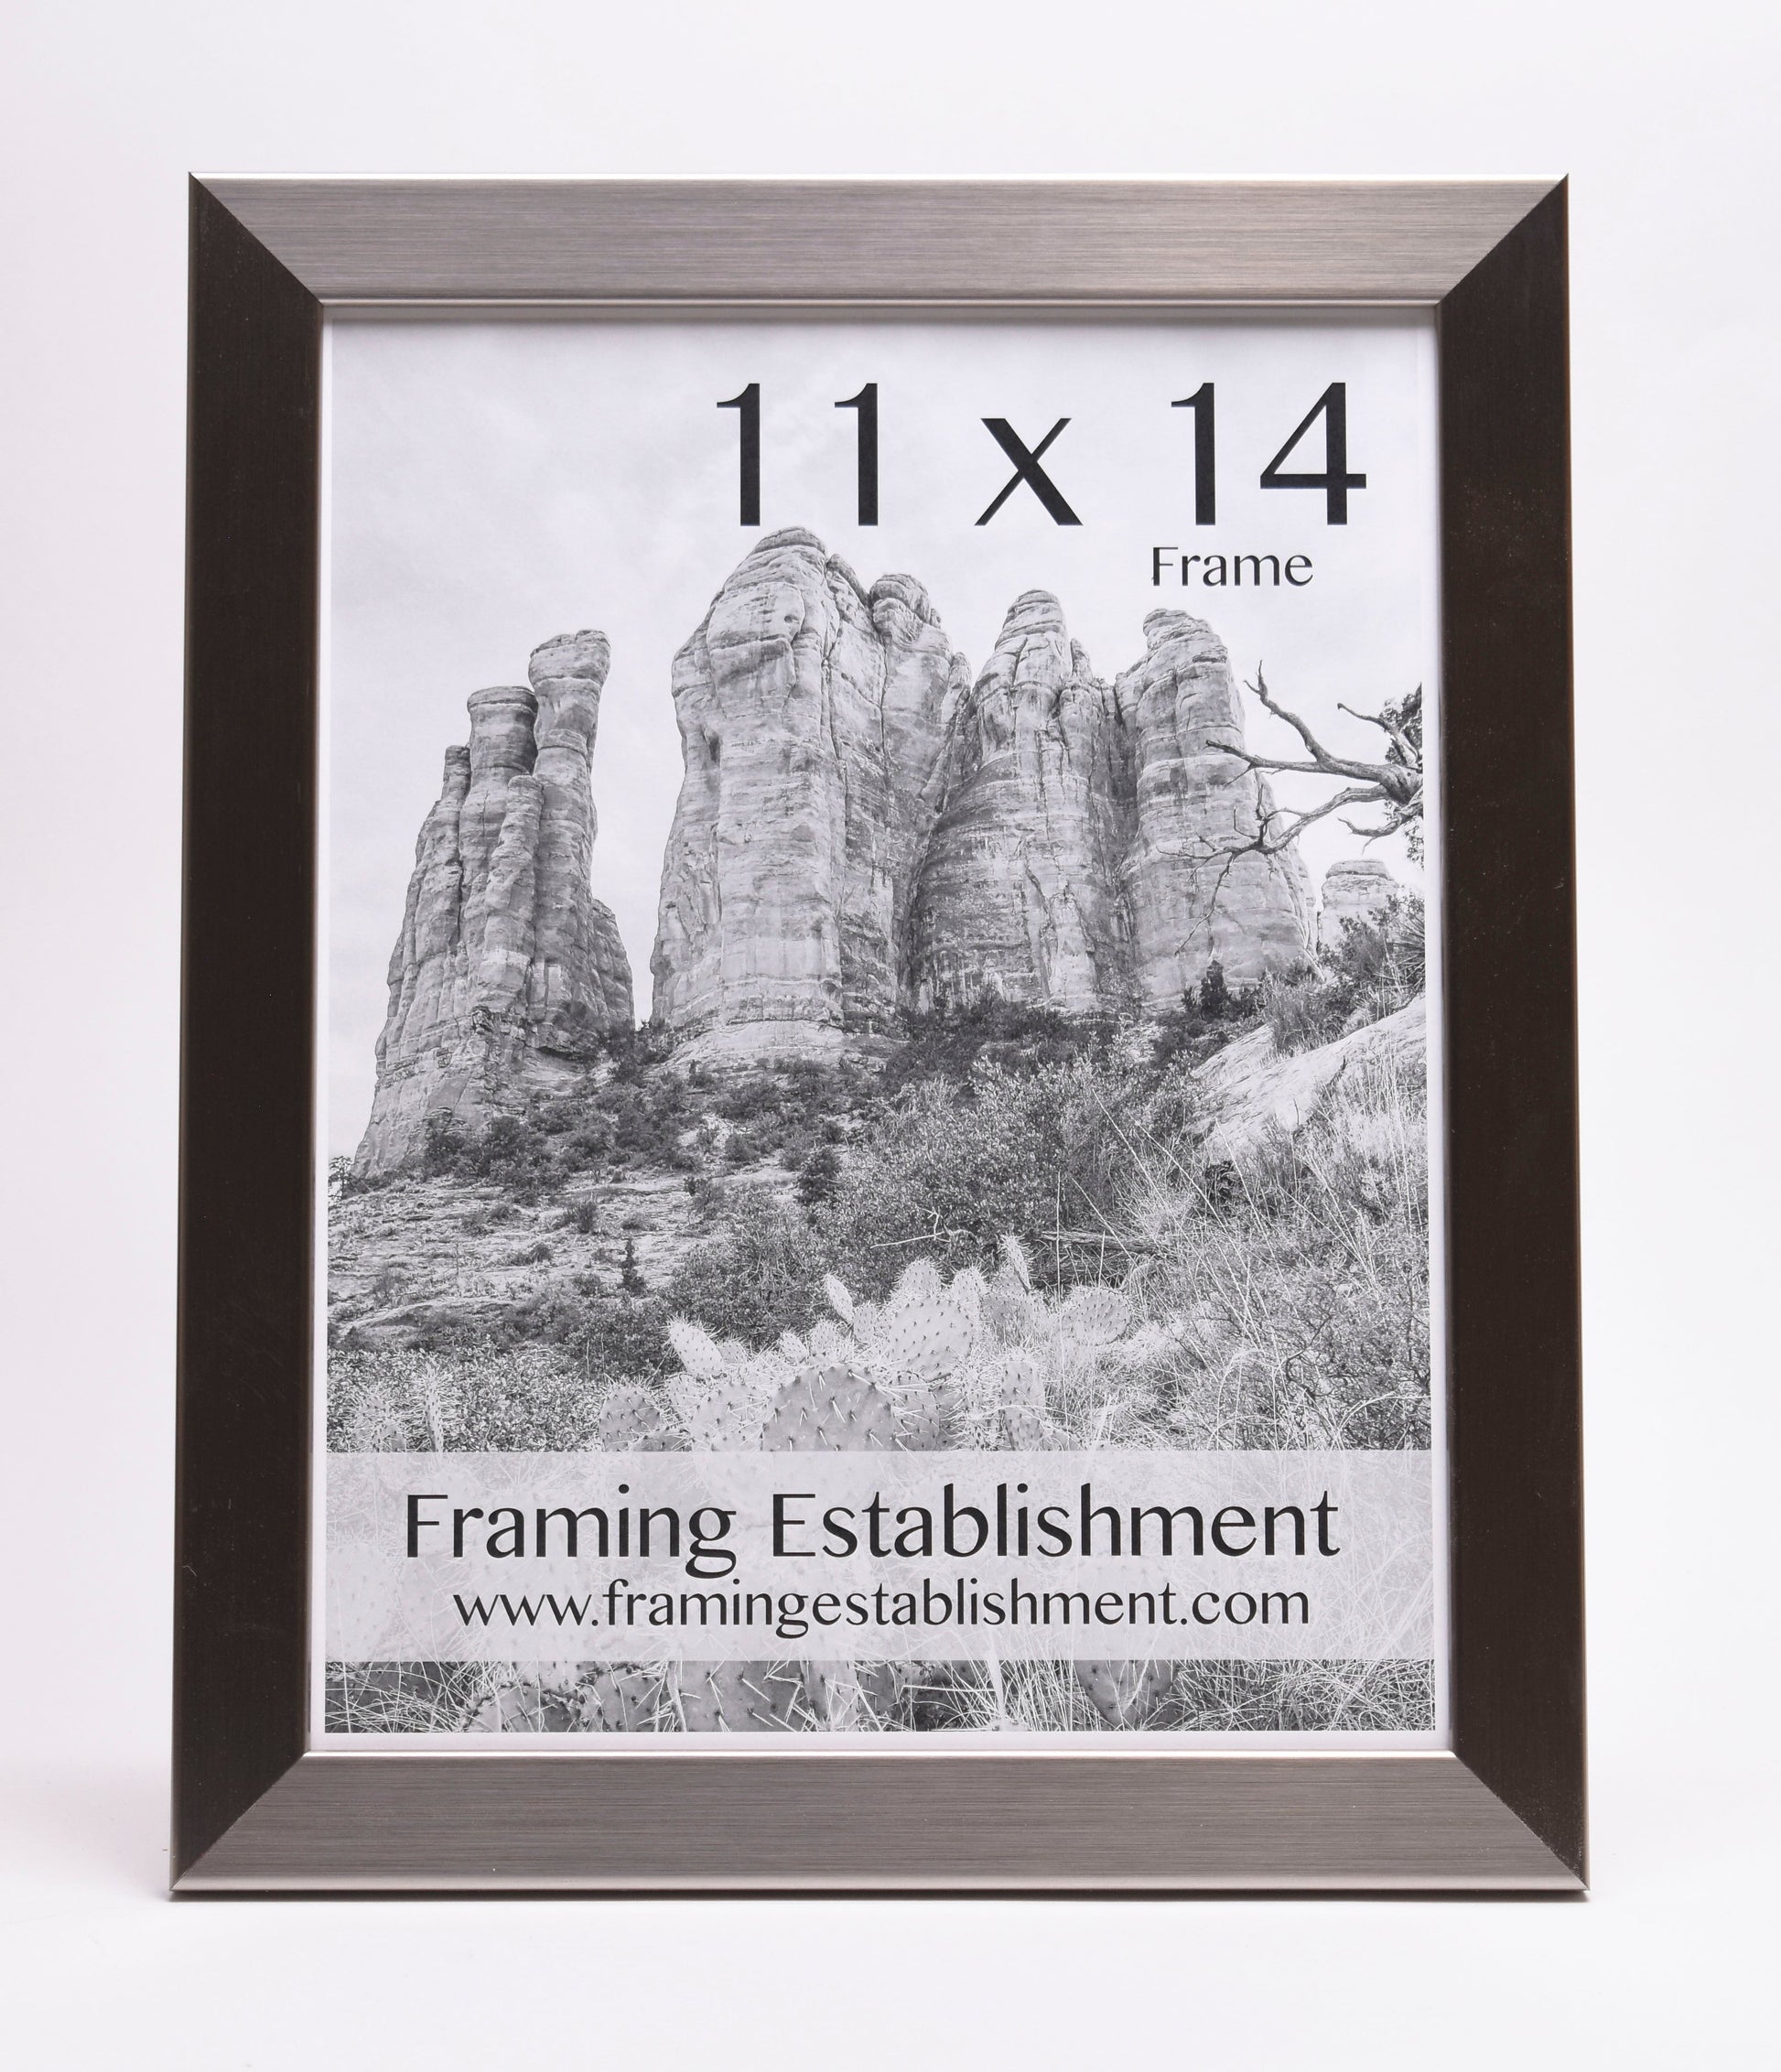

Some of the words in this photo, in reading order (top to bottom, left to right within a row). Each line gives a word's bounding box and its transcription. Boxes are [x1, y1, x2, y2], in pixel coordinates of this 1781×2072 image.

[717, 383, 879, 526] 11
[975, 417, 1082, 525] x
[1171, 382, 1366, 525] 14
[1151, 546, 1313, 586] Frame
[407, 1484, 737, 1578] Framing
[772, 1483, 1341, 1558] Establishment
[453, 1578, 1309, 1639] www.framingestablishment.com
